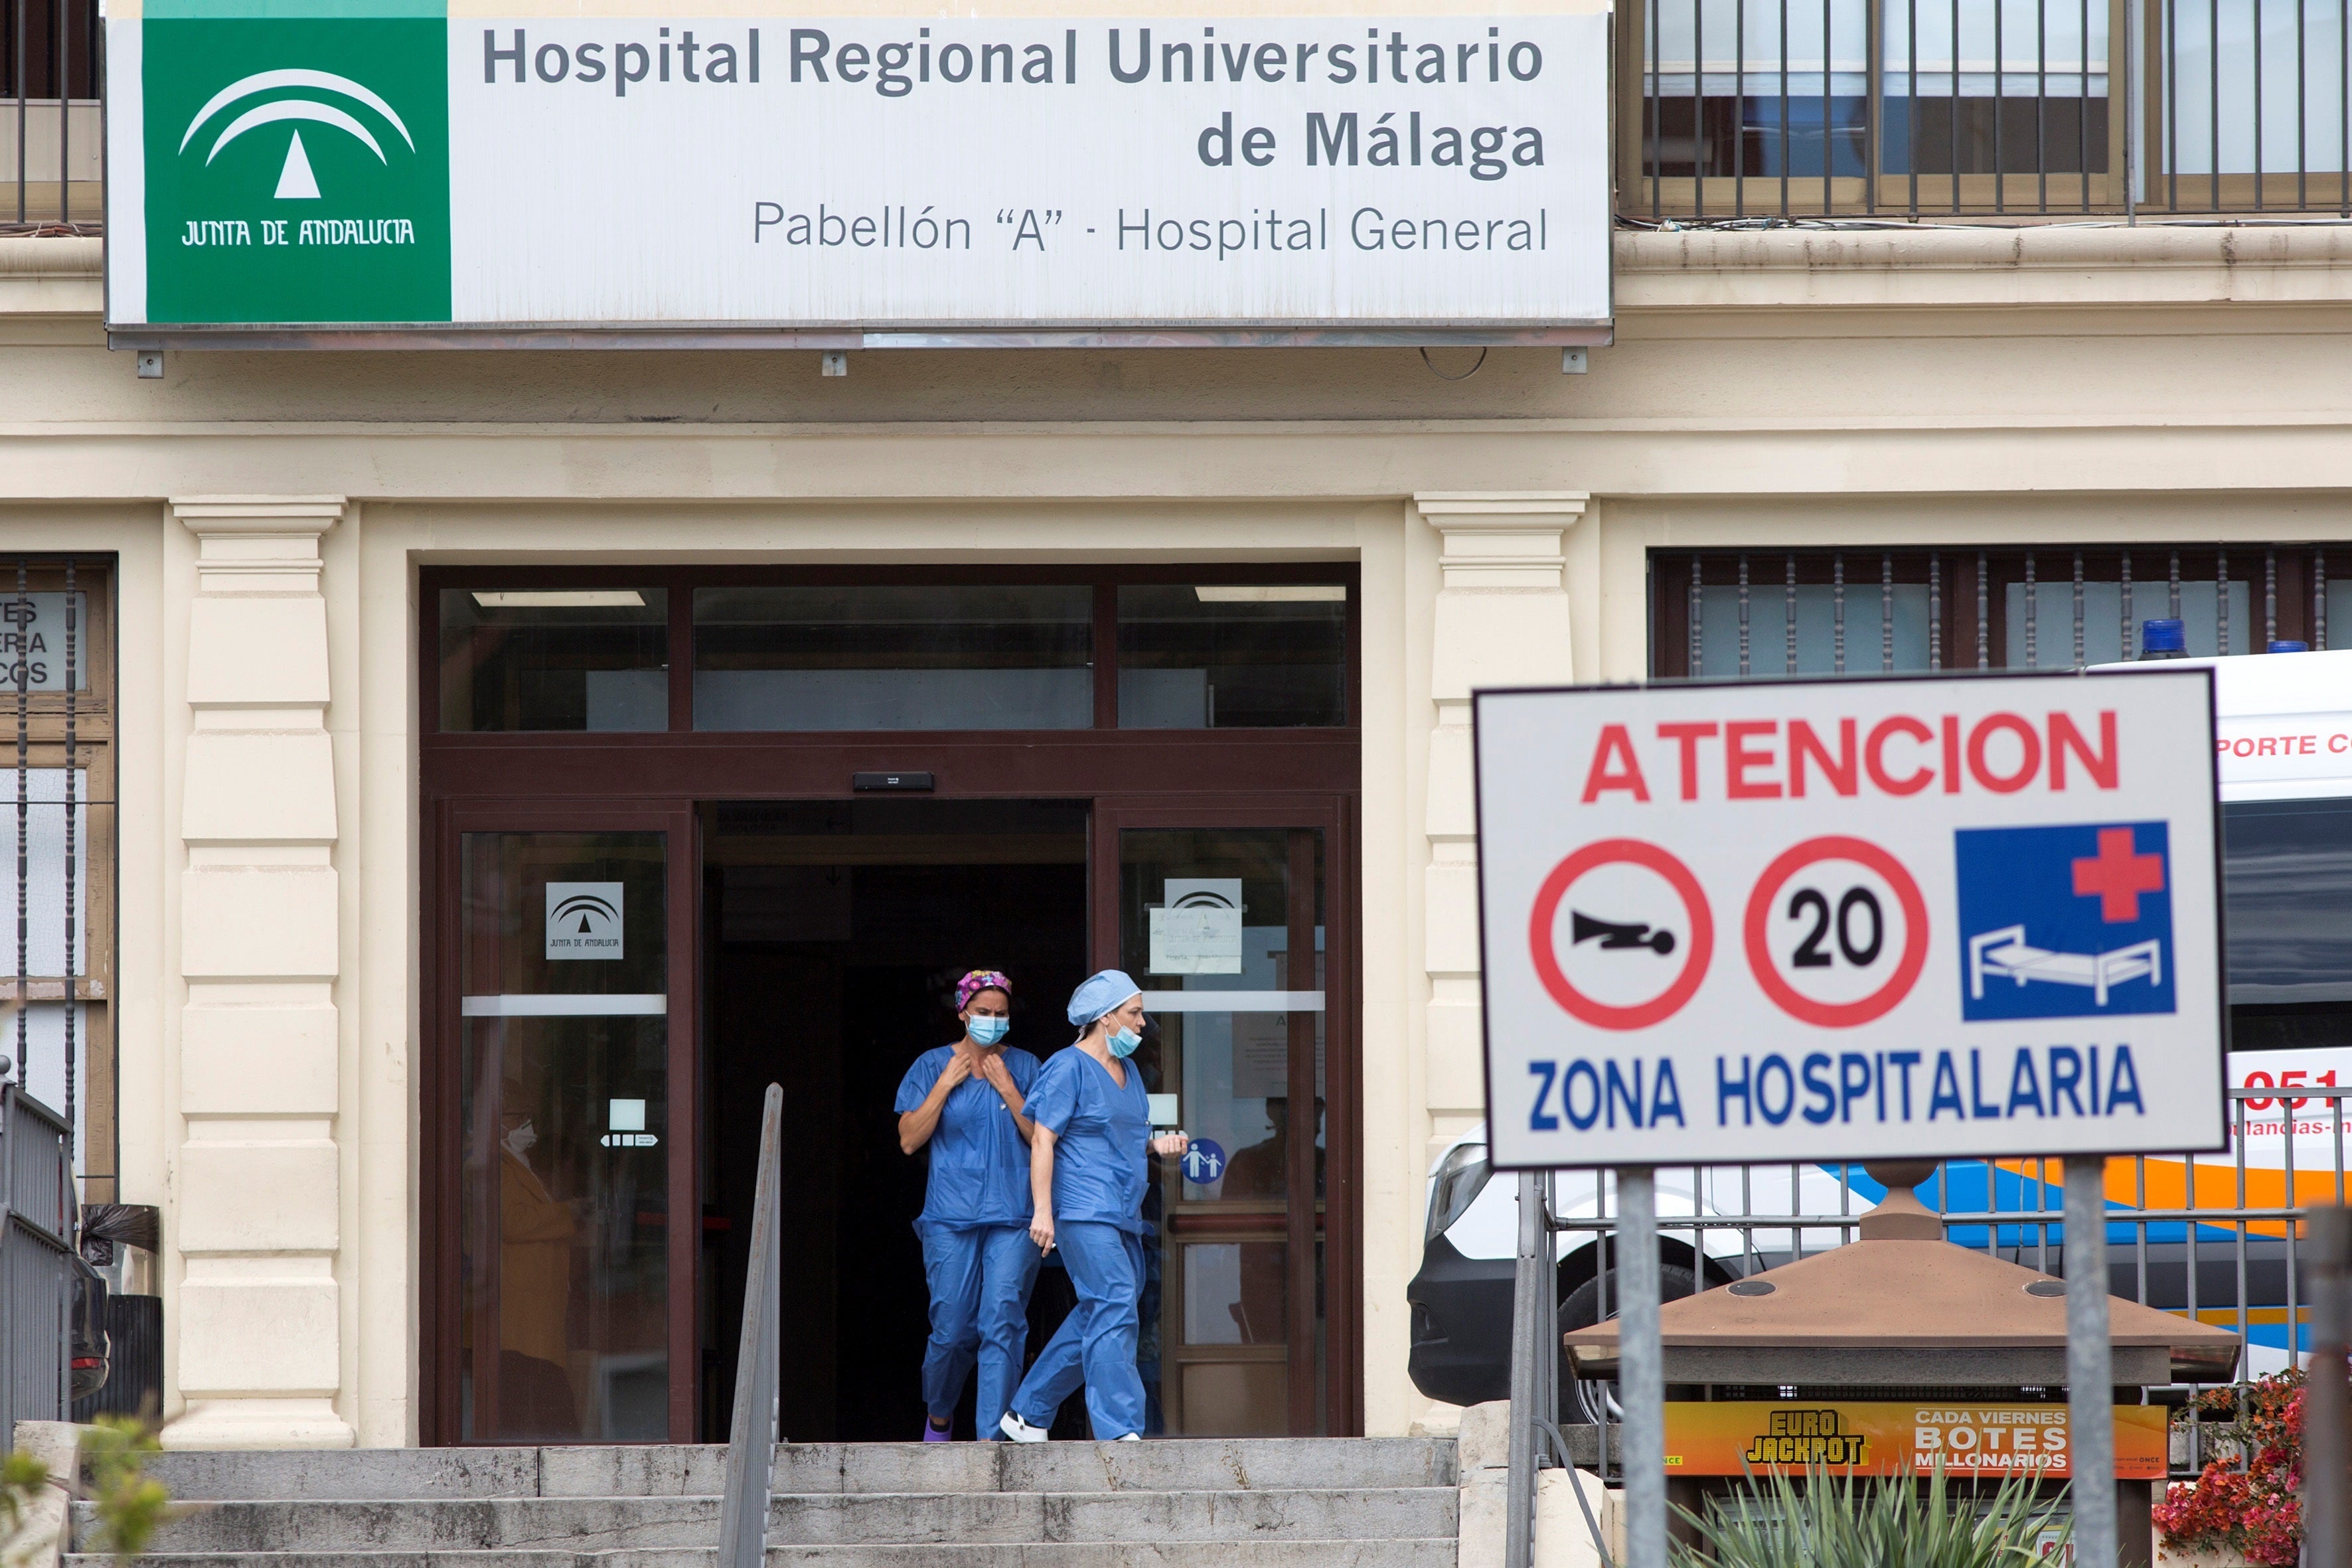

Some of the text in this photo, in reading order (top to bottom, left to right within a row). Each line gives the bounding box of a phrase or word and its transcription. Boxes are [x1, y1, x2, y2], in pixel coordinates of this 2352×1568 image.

[484, 27, 1543, 98] Hospital Regional Universitario
[1198, 112, 1545, 182] de Málaga
[182, 219, 415, 246] JUNTA DE ANDALUCIA
[755, 202, 971, 250] Pabellón
[997, 209, 1063, 252] “A”
[1119, 208, 1326, 262] Hospital
[1352, 208, 1546, 252] General
[0, 601, 37, 623] ES
[0, 633, 47, 653] RA
[1581, 709, 2121, 805] ATENCION
[2327, 733, 2352, 754] C
[1788, 886, 1884, 969] 20
[550, 939, 619, 947] JUNTA DE ANDALUCIA
[1528, 1044, 2146, 1132] ZONA HOSPITALARIA
[2244, 1070, 2337, 1113] 051
[1770, 1411, 1838, 1437] EURO
[1915, 1411, 2067, 1425] CADA VIERNES
[1747, 1437, 1861, 1464] JACKPOT
[1915, 1426, 2067, 1451] BOTES
